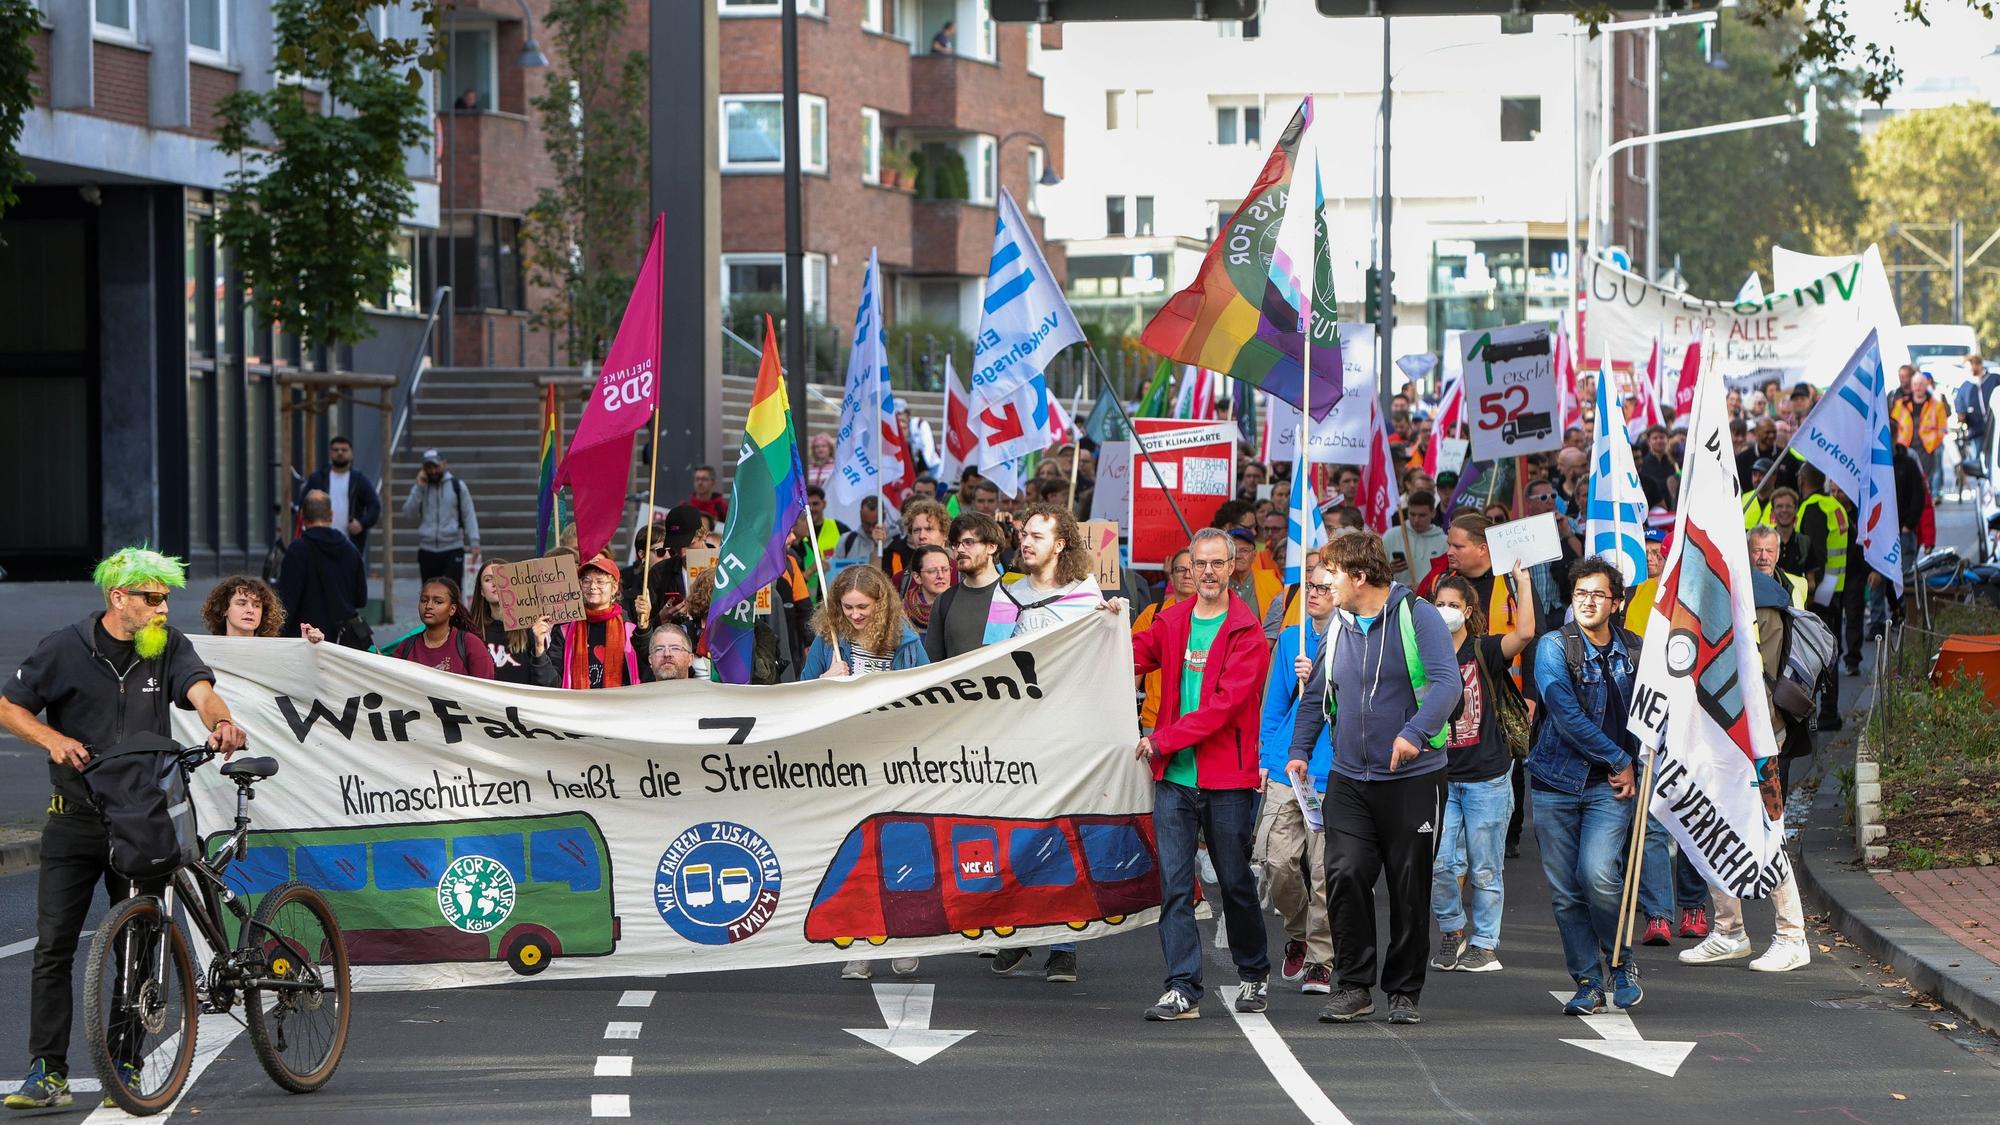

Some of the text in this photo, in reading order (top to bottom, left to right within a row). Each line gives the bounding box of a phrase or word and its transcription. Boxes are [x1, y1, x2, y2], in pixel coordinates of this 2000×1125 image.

[1729, 317, 1779, 341] ALLE
[1478, 385, 1535, 431] 52
[1165, 432, 1221, 447] KLIMAKARTE
[274, 692, 421, 744] Wir
[339, 745, 1039, 816] Klimaschützen heißt die Streikenden unterstützen
[441, 858, 513, 922] FRIDAYS FOR FUTURE
[657, 823, 780, 913] WIR FAHREN ZUSAMMEN
[466, 918, 492, 931] Köln
[729, 892, 777, 939] TVN24
